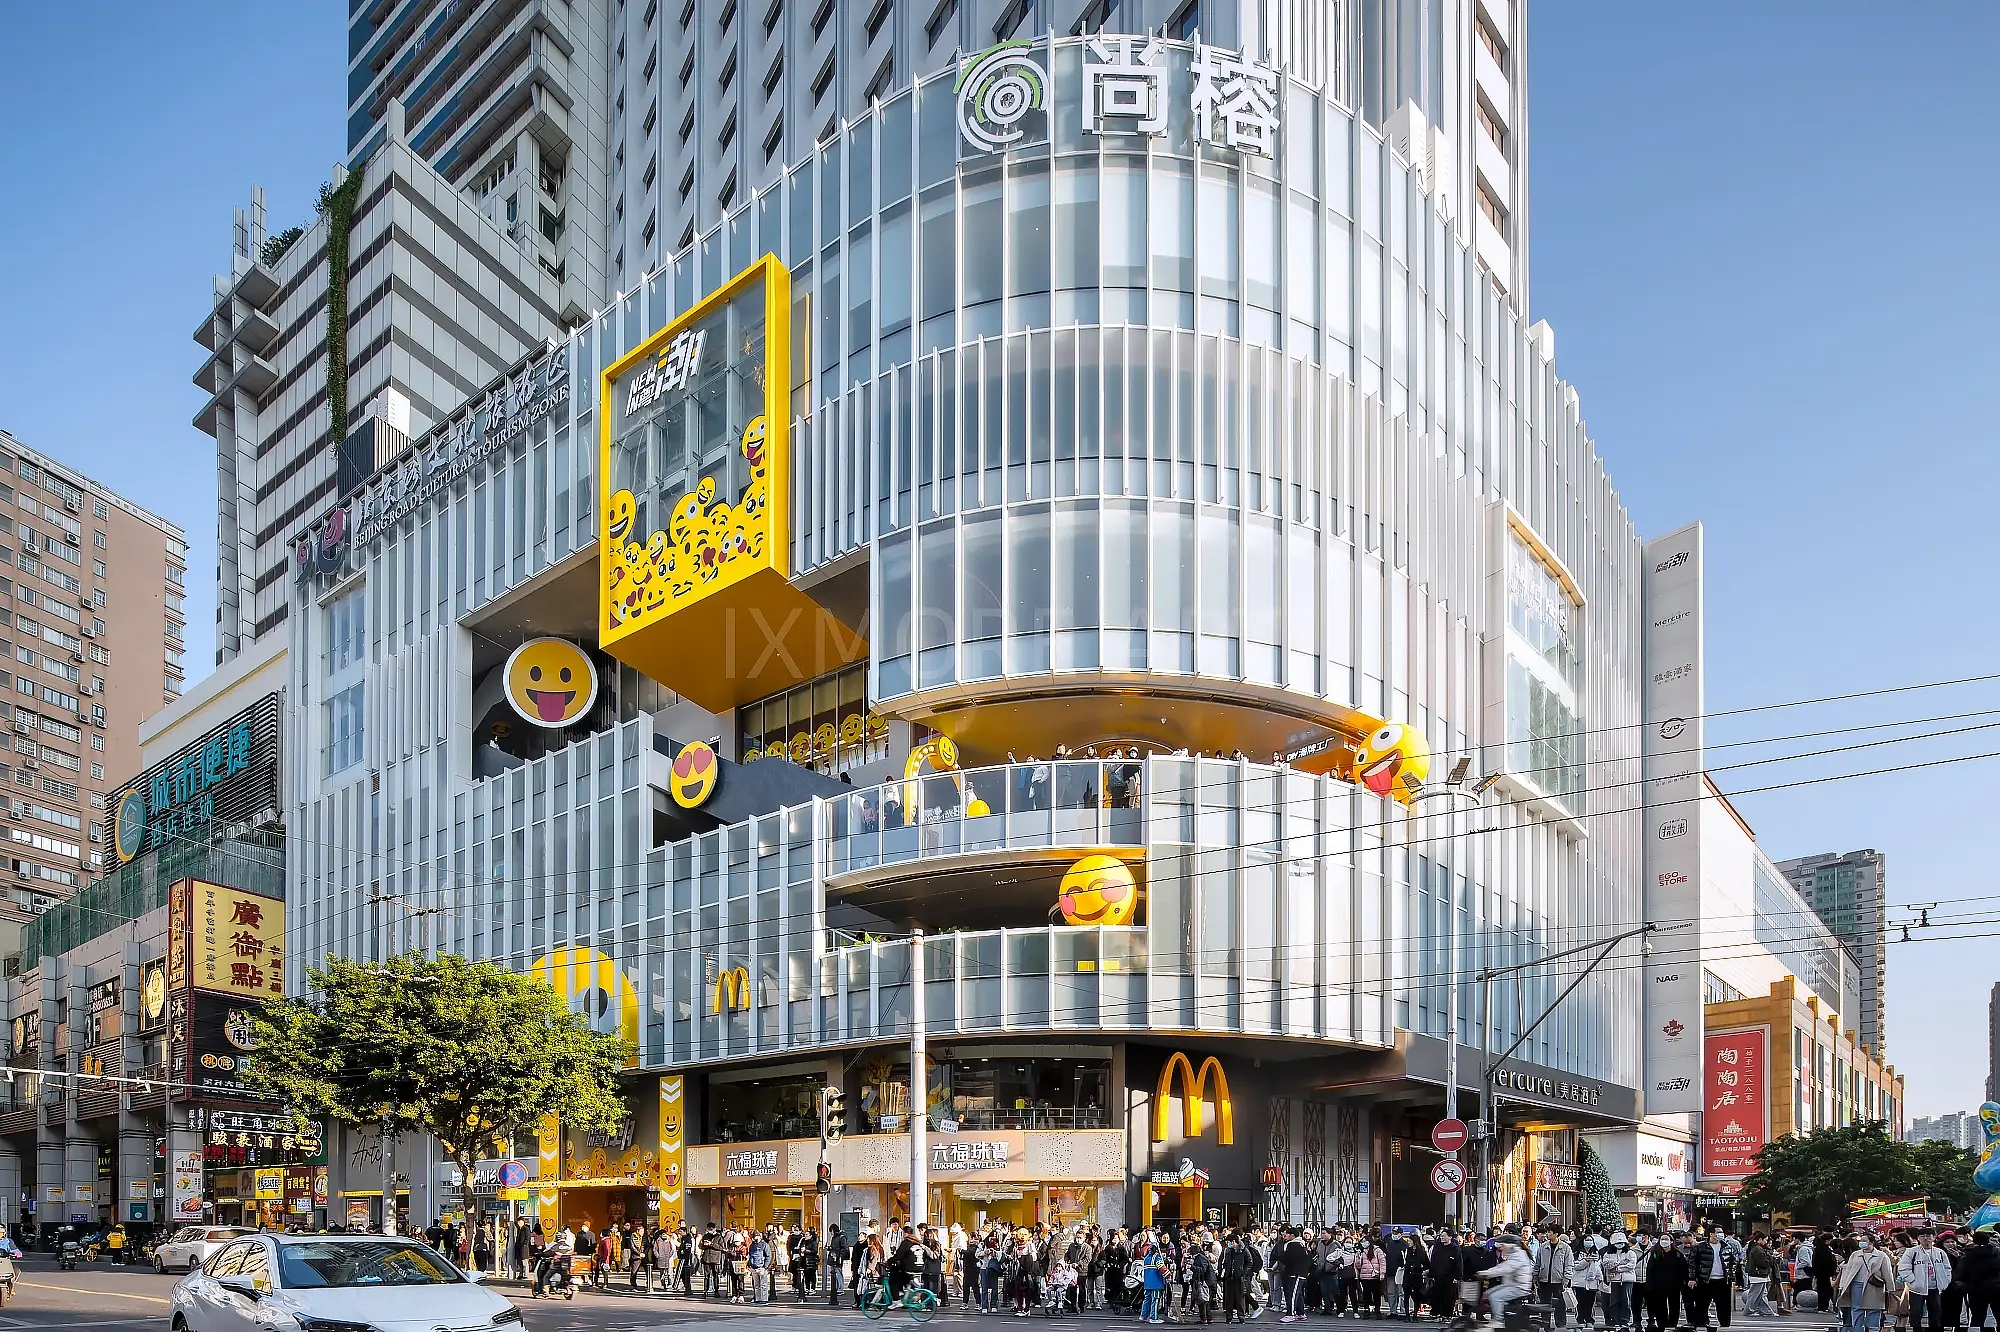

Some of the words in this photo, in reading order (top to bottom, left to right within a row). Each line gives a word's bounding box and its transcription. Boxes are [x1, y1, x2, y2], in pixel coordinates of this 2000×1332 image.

[1083, 37, 1281, 160] 尚榕
[354, 515, 389, 549] BEIJING
[389, 495, 418, 524] ROAD
[420, 450, 477, 506] CULTURAL
[474, 408, 534, 460] TOURISM
[531, 383, 570, 421] ZONE
[1654, 611, 1691, 628] Mercure
[151, 722, 252, 817] 城市便捷
[1658, 871, 1679, 882] EGO
[1659, 875, 1688, 887] STORE
[228, 900, 264, 990] 廣御點
[1656, 974, 1679, 984] NAG
[1493, 1068, 1551, 1096] ercure
[1712, 1048, 1740, 1110] 陶陶居
[1560, 1081, 1598, 1106] 美居酒店
[211, 1131, 297, 1151] 駿豪酒家
[1709, 1136, 1757, 1145] TAOTAOJU
[726, 1150, 778, 1171] 六福珠寶
[932, 1141, 1010, 1163] 六福珠寶
[726, 1169, 750, 1177] LUKFOOK
[750, 1168, 778, 1177] JEWELLERY
[932, 1162, 966, 1171] LUKFOOK
[966, 1161, 1009, 1171] JEWELLERY
[1555, 1168, 1581, 1179] CHAGEE
[1152, 1171, 1180, 1183] 甜品站
